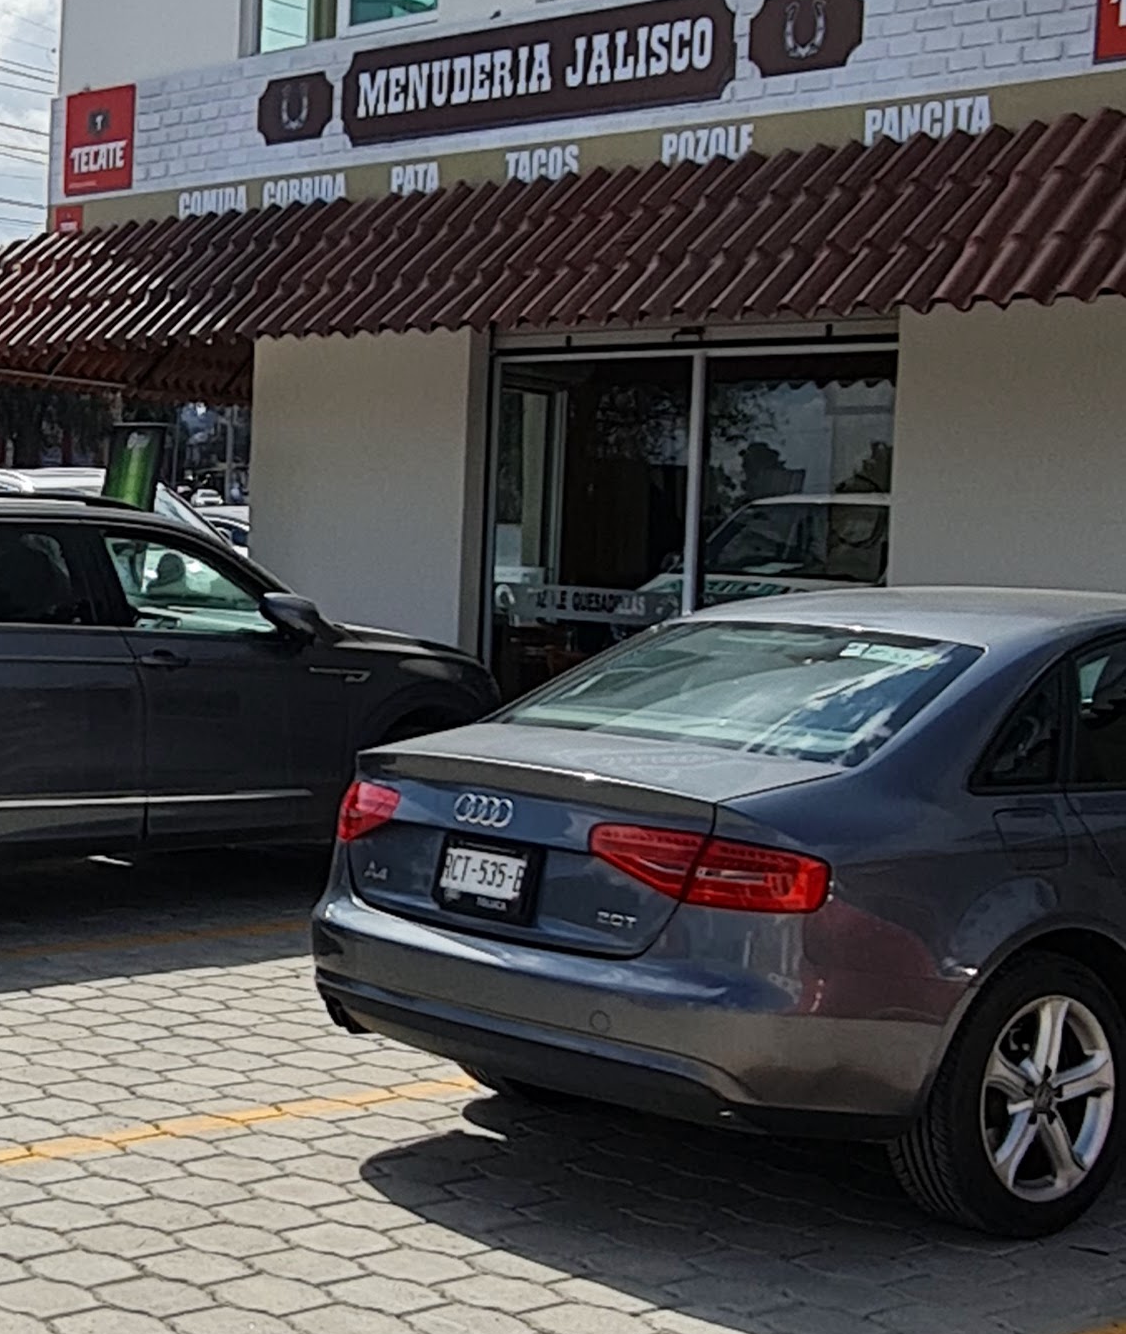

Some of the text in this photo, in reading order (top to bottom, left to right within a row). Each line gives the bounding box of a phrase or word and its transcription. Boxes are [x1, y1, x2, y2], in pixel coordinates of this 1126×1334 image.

[356, 16, 715, 119] MENUDERIA JALISCO
[864, 94, 992, 148] PANCITA
[69, 139, 129, 174] TECATE
[661, 123, 755, 165] POZOLE
[390, 161, 440, 196] PATA
[505, 145, 580, 183] TACOS
[178, 184, 248, 220] COMIDA
